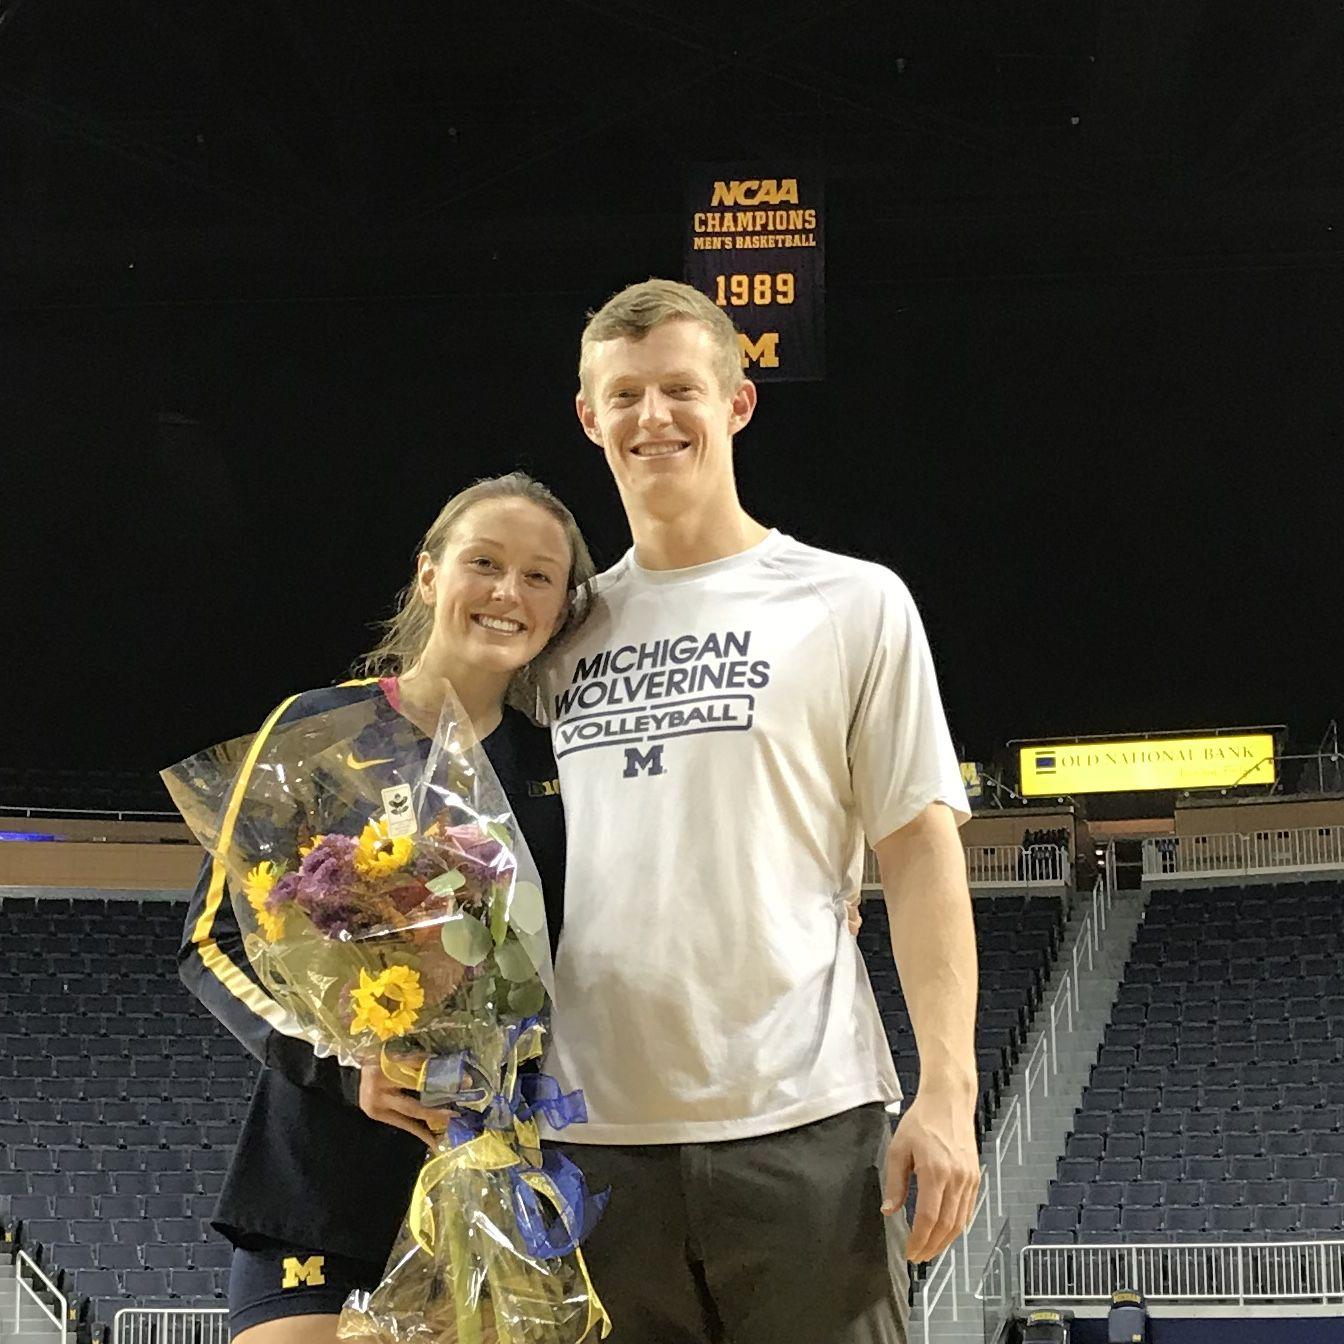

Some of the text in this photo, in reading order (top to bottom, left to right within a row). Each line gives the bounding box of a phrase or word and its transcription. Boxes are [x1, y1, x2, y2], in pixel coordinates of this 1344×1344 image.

[711, 178, 799, 206] NCAA
[693, 209, 817, 233] CHAMPIONS
[693, 233, 817, 251] MEN'S BASKETBALL
[716, 273, 795, 306] 1989
[737, 332, 780, 368] M
[571, 630, 752, 684] MICHIGAN
[556, 660, 771, 715] WOLVERINES
[561, 704, 738, 745] VOLLEYBALL
[622, 744, 665, 779] M
[282, 1255, 325, 1289] M
